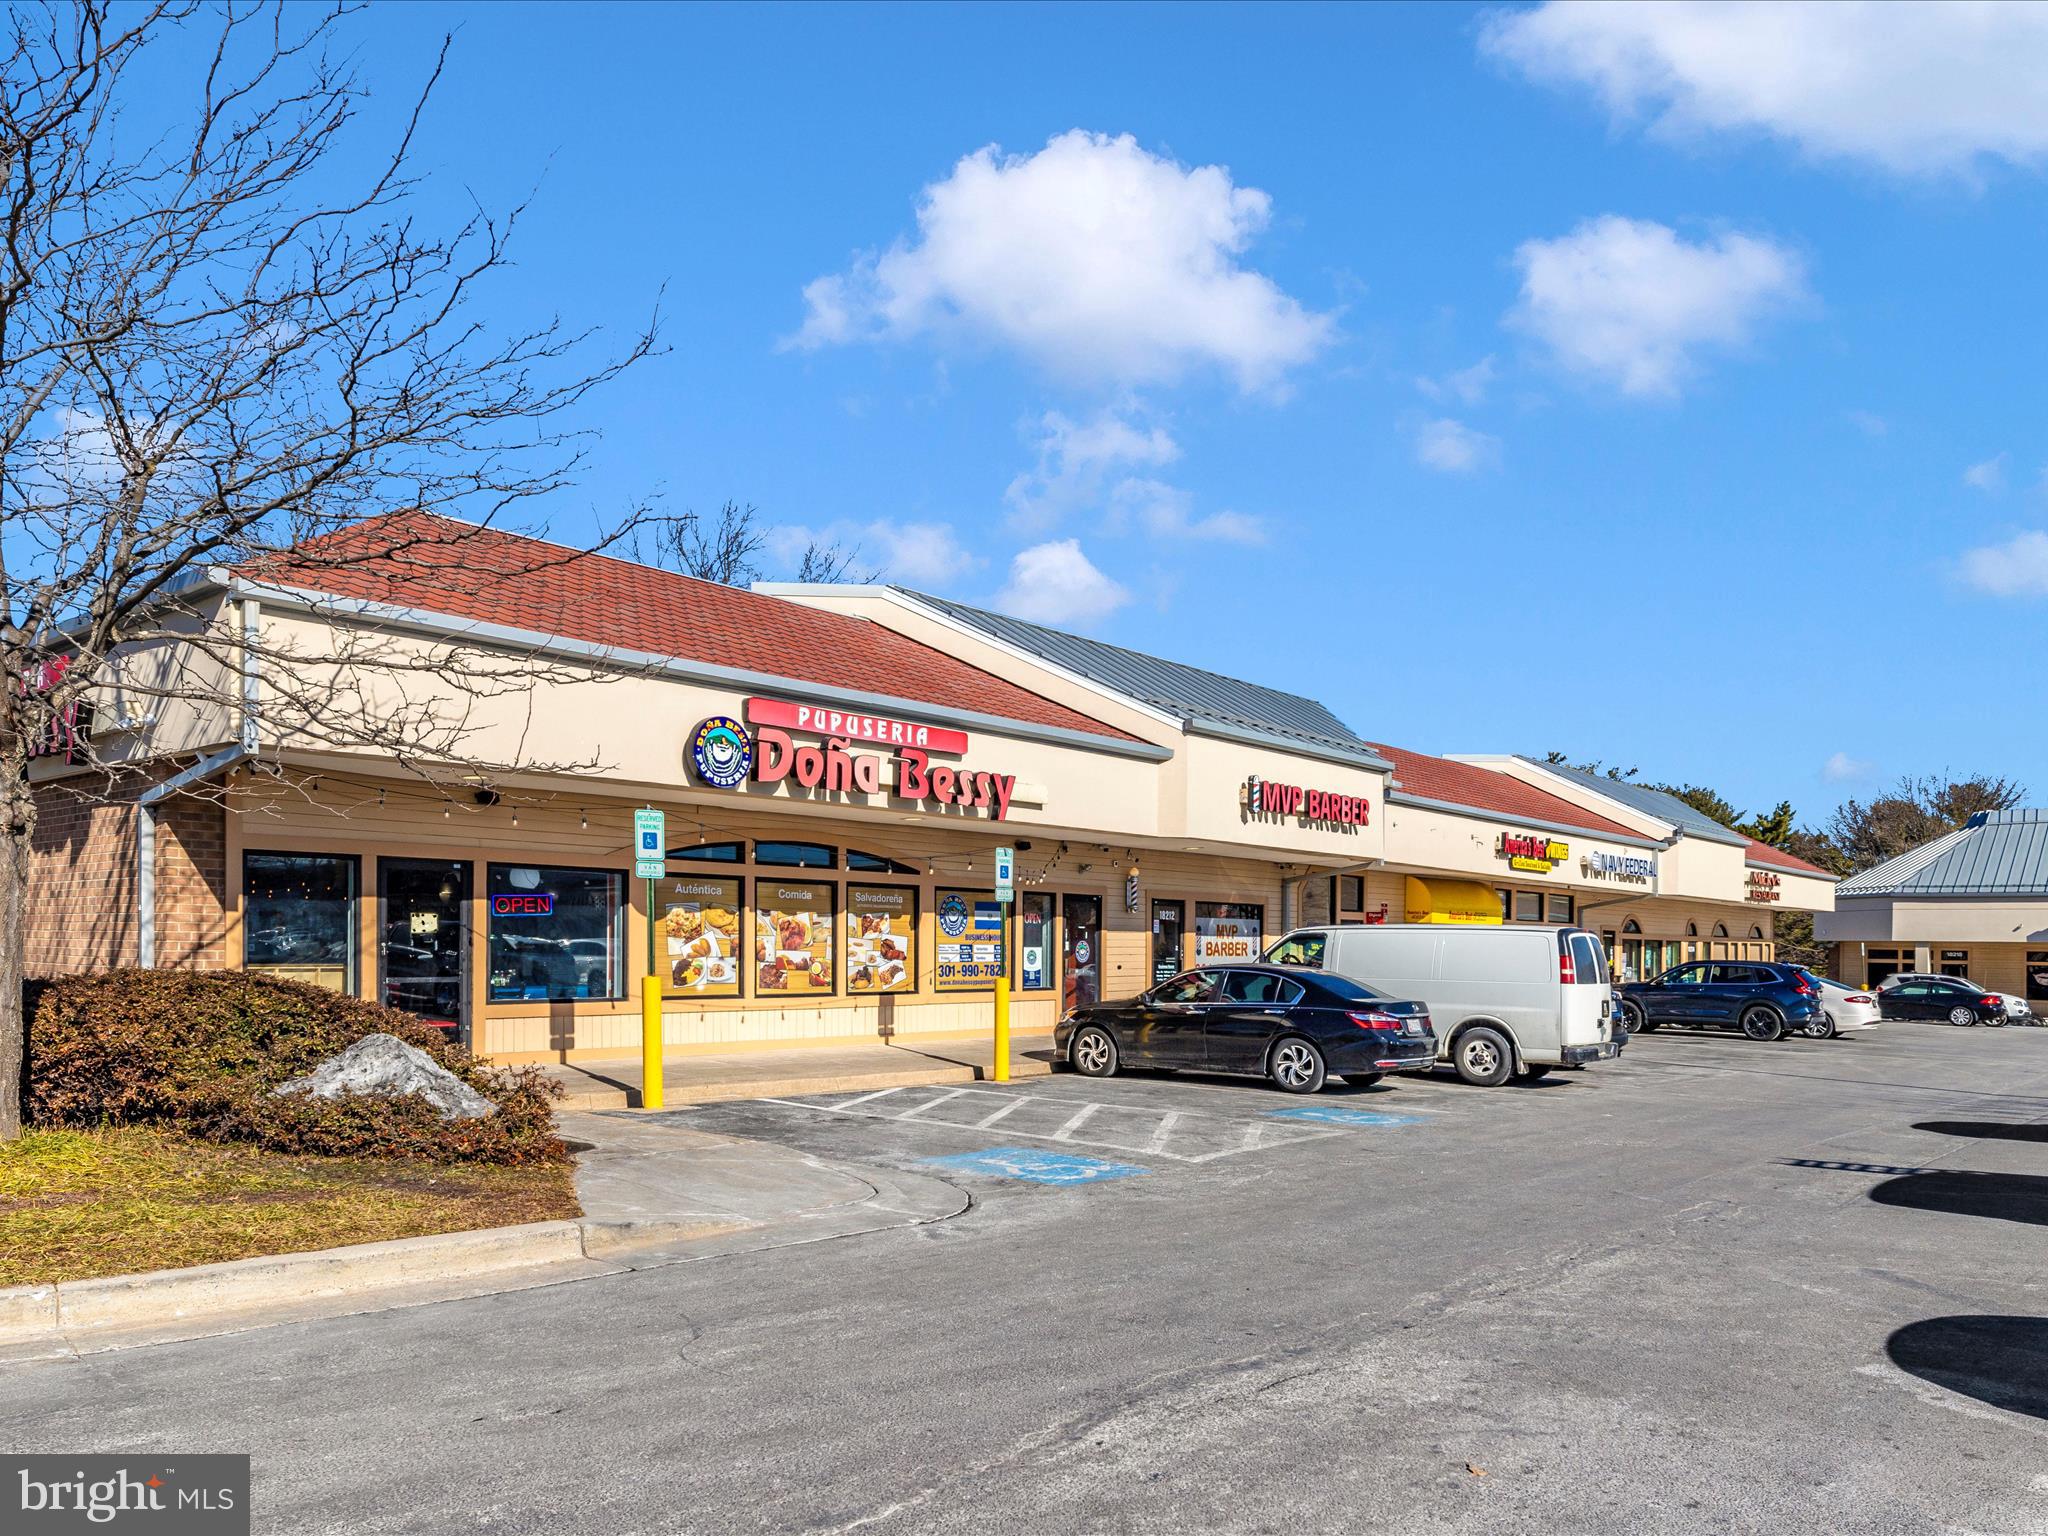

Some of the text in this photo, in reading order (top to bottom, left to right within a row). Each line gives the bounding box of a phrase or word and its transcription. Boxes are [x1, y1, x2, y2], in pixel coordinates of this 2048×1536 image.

[798, 706, 929, 746] PUPUSERIA
[696, 719, 750, 755] DOÑA BESSY
[696, 754, 750, 785] PUPUSERIA
[757, 727, 1017, 822] Doña Bessy
[1262, 780, 1370, 827] MVP BARBER
[636, 814, 662, 823] RESERVED
[639, 823, 661, 831] PARKING
[1504, 832, 1532, 857] America's
[1532, 836, 1546, 858] Best
[1601, 854, 1658, 878] NAVY FEDERAL
[674, 883, 722, 896] Auténtica
[778, 888, 813, 900] Comida
[494, 897, 550, 914] OPEN
[855, 892, 904, 904] Salvadoreña
[1024, 913, 1041, 924] OPEN
[1159, 910, 1175, 920] 18212
[1216, 924, 1238, 939] MVP
[1206, 941, 1248, 957] BARBER
[938, 964, 1006, 977] 301-990-782
